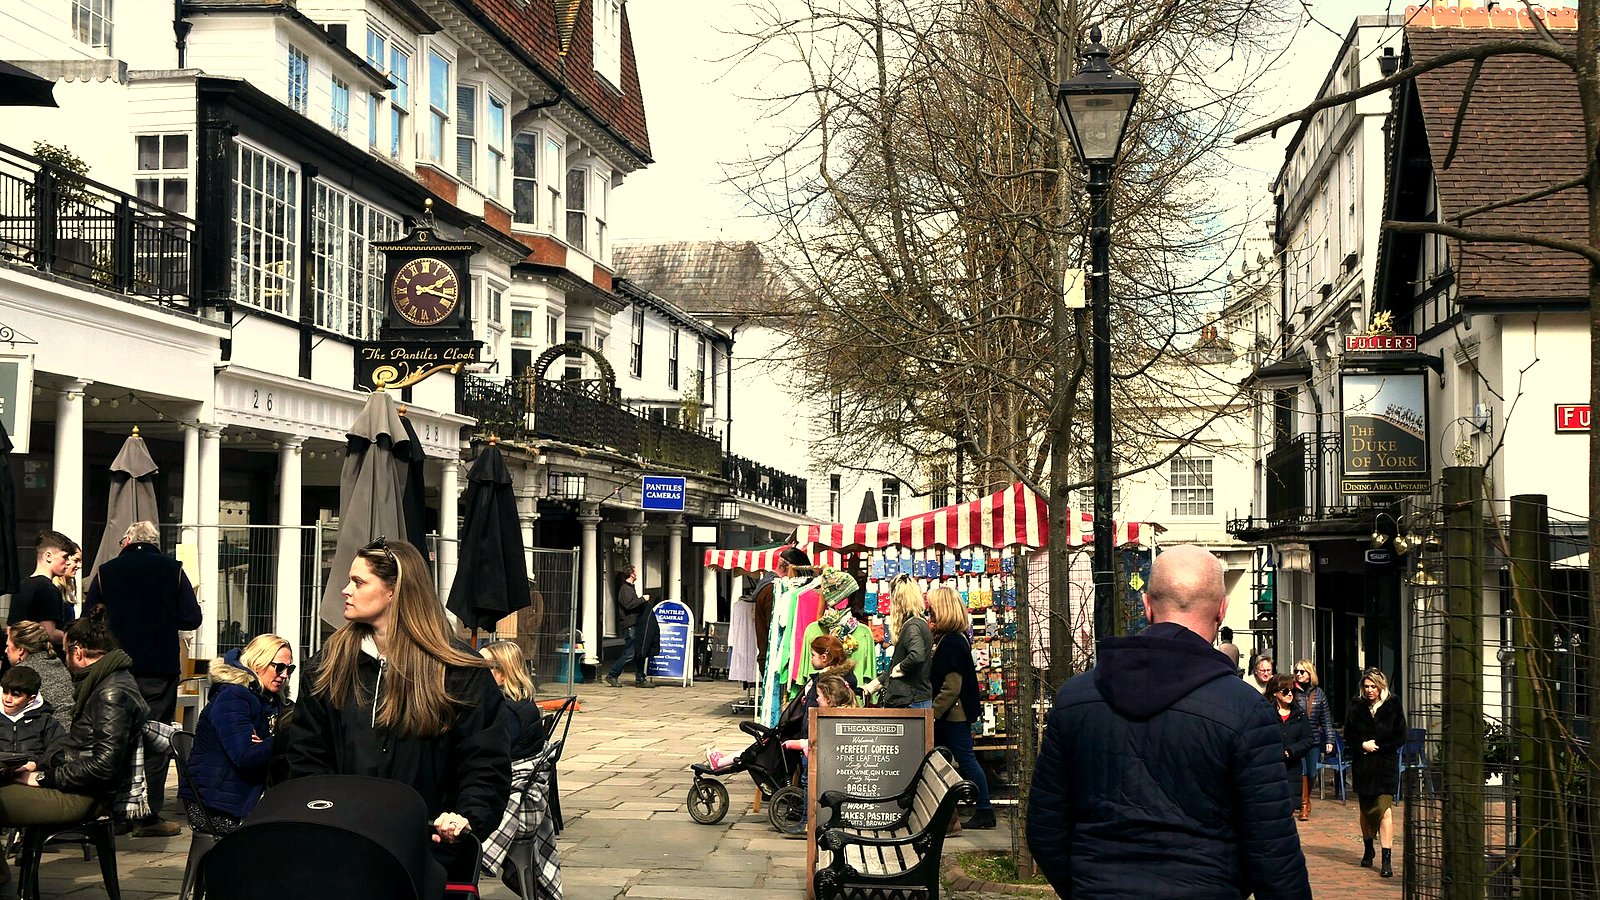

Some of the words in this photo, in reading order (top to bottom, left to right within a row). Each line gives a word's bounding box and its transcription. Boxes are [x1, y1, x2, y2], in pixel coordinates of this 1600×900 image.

[1349, 336, 1412, 349] FULLER'S
[361, 347, 386, 360] The
[390, 347, 438, 360] Pantiles
[443, 347, 475, 360] Clock
[1349, 424, 1375, 437] THE
[1351, 437, 1398, 452] DUKE
[1377, 453, 1418, 467] YORK
[646, 483, 682, 492] PANTILES
[1344, 482, 1372, 491] DINING
[1373, 482, 1393, 491] AREA
[1394, 482, 1427, 491] UPSTAIRS
[646, 491, 681, 500] CAMERAS
[840, 744, 869, 754] PERFECT
[871, 744, 900, 755] COFFEES
[873, 755, 891, 763] TEAS
